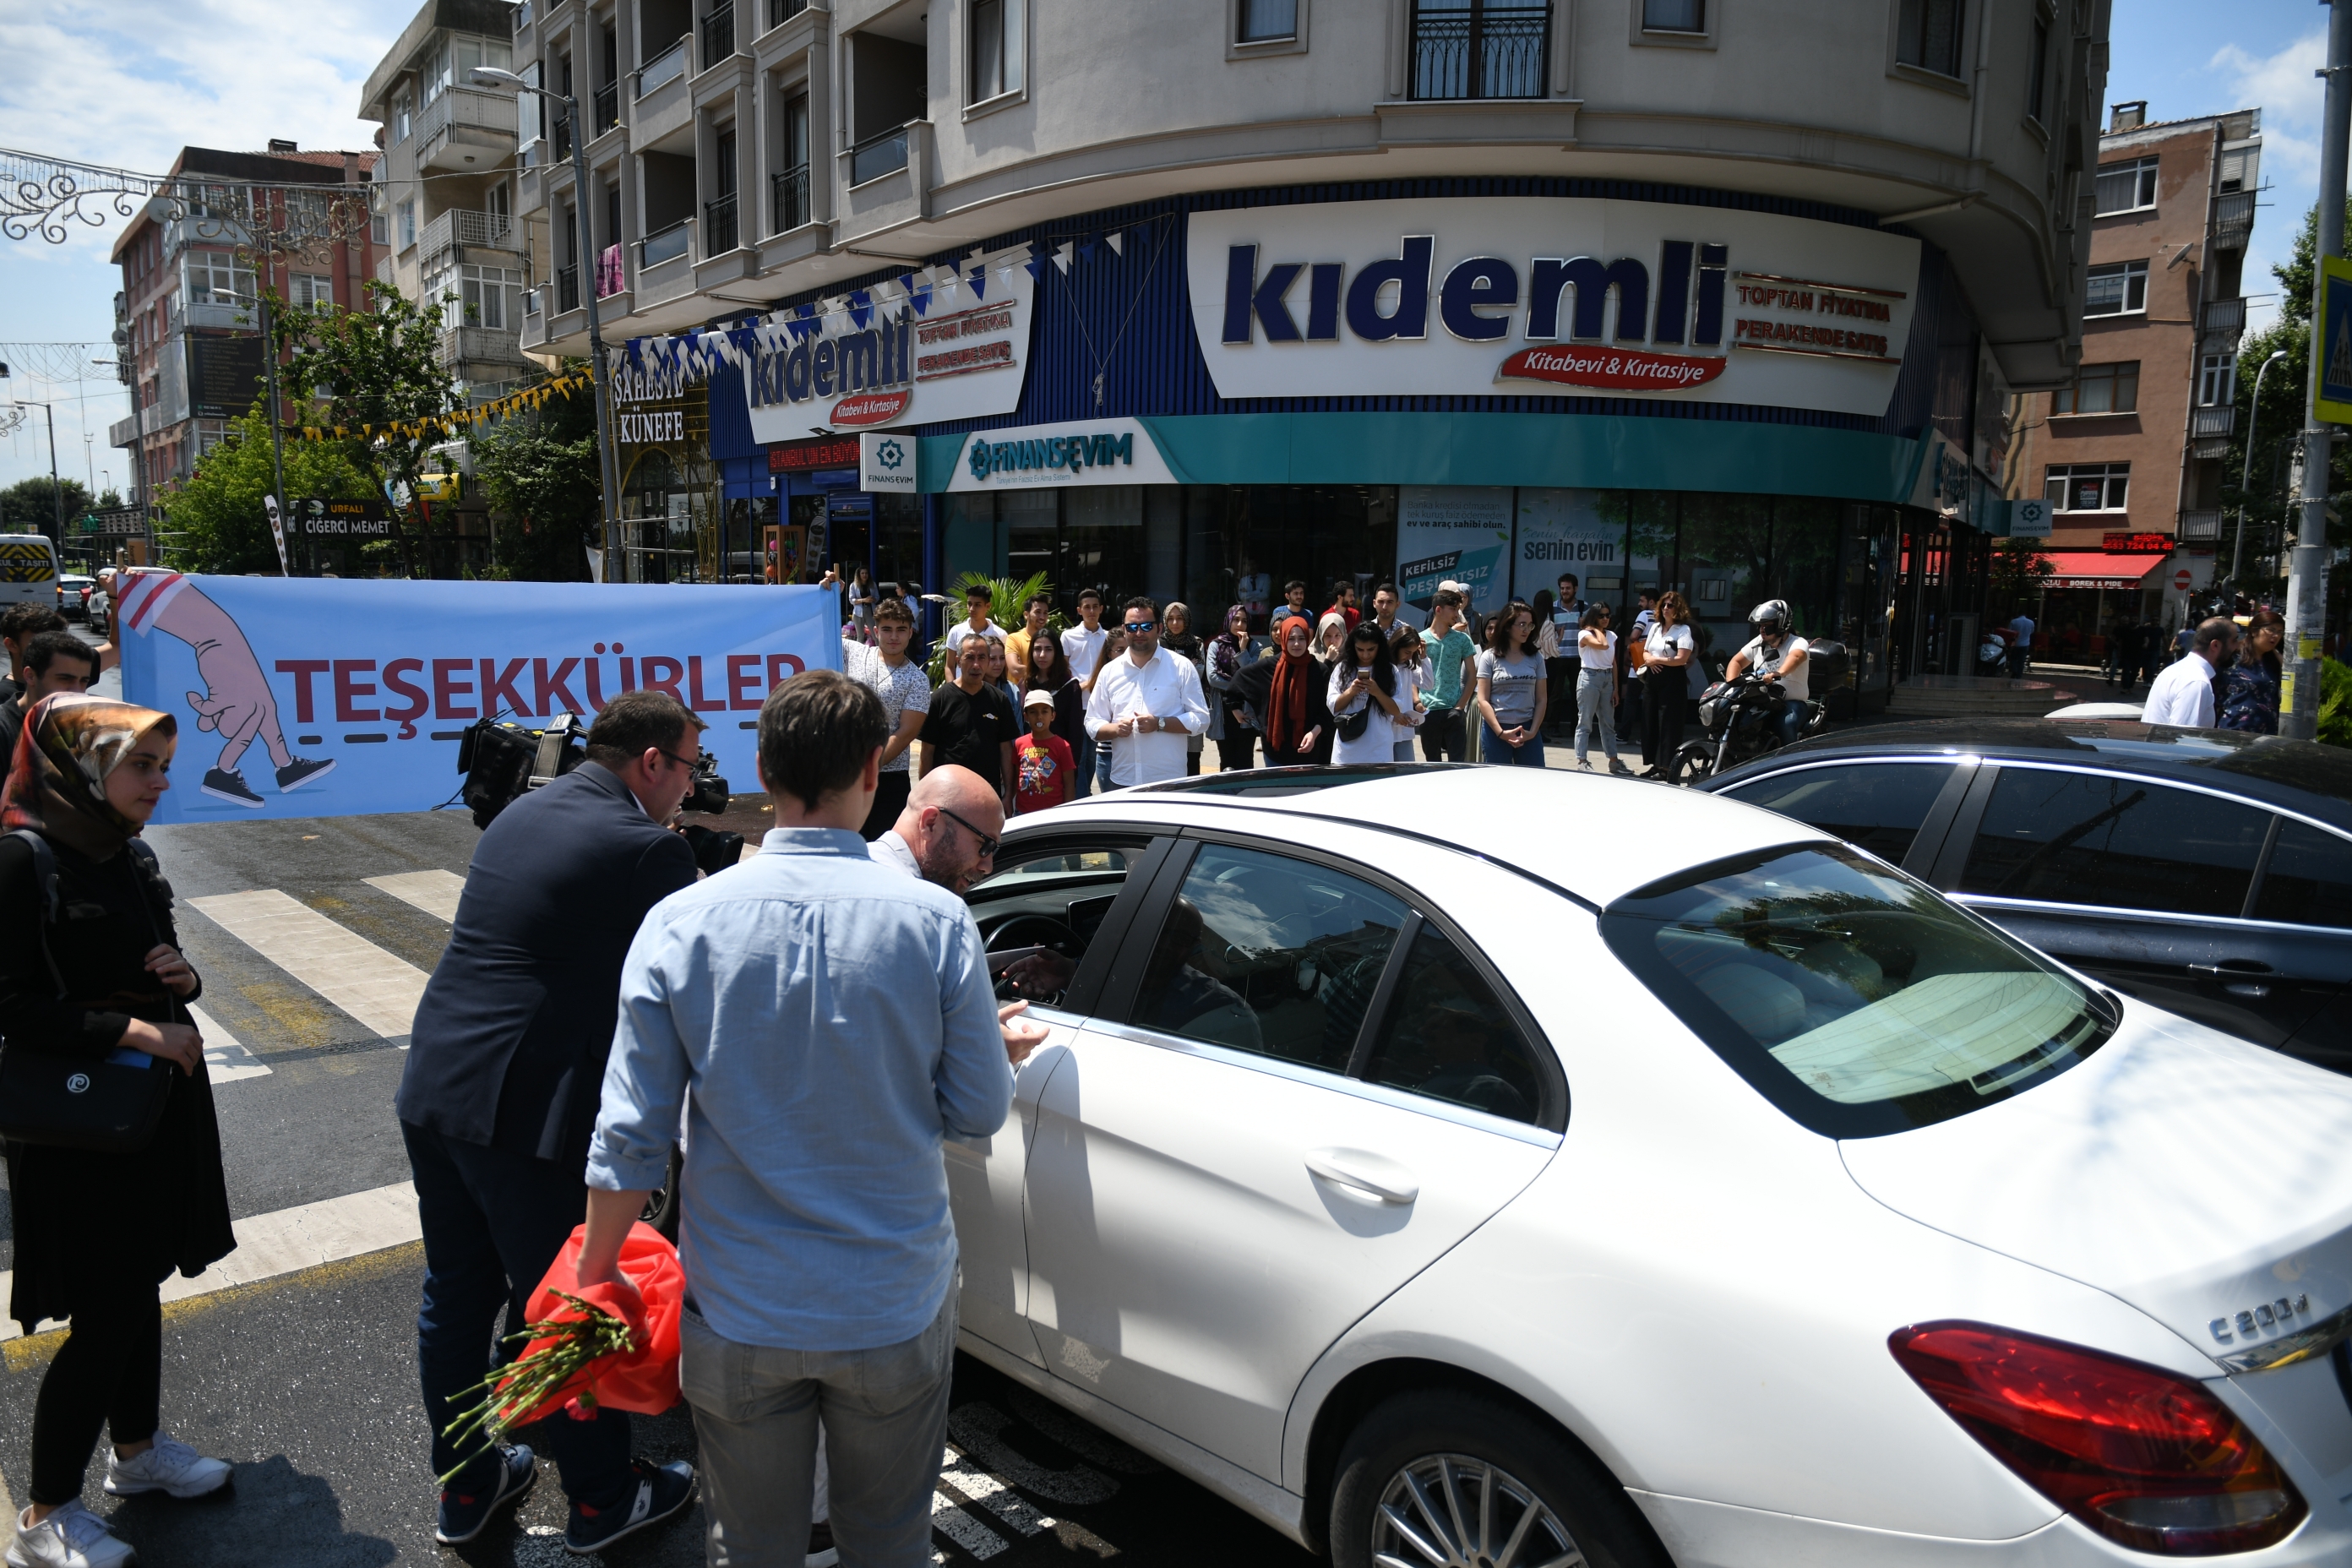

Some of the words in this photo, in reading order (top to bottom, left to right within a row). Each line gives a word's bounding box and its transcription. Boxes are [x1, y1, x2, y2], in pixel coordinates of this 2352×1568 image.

[1221, 234, 1729, 346] kıdemli
[1739, 286, 1814, 310] TOPTAN
[917, 323, 957, 345] TOPTAN
[1736, 318, 1844, 348] PERAKENDE
[1846, 330, 1887, 357] SATIŞ
[917, 347, 977, 371] PERAKENDE
[1524, 351, 1605, 373] Kitabevi
[1606, 357, 1620, 374] &
[1622, 358, 1704, 384] Kırtasiye
[836, 400, 862, 418] Kitabevi
[863, 401, 869, 415] &
[869, 397, 900, 414] Kırtasiye
[620, 405, 684, 443] KÜNEFE
[832, 440, 860, 462] BÜYÜ
[1053, 473, 1070, 482] Sistemi
[330, 504, 363, 514] URFALI
[1407, 501, 1433, 509] Banka
[1435, 501, 1462, 510] kredisi
[1463, 502, 1500, 510] olmadan
[1407, 510, 1419, 519] tek
[1421, 510, 1444, 520] kuruş
[1446, 510, 1460, 519] faiz
[1462, 510, 1505, 520] ödemeden
[306, 516, 347, 534] CİĞERCİ
[351, 520, 390, 534] MEMET
[1432, 521, 1451, 530] araç
[1453, 520, 1481, 529] sahibi
[1483, 520, 1506, 529] olun.
[1524, 529, 1559, 539] senin
[1562, 525, 1615, 544] hayalin
[1523, 538, 1574, 561] senin
[1577, 539, 1614, 562] evin
[19, 559, 50, 569] TAŞITI
[1405, 555, 1455, 577] KEFİLSİZ
